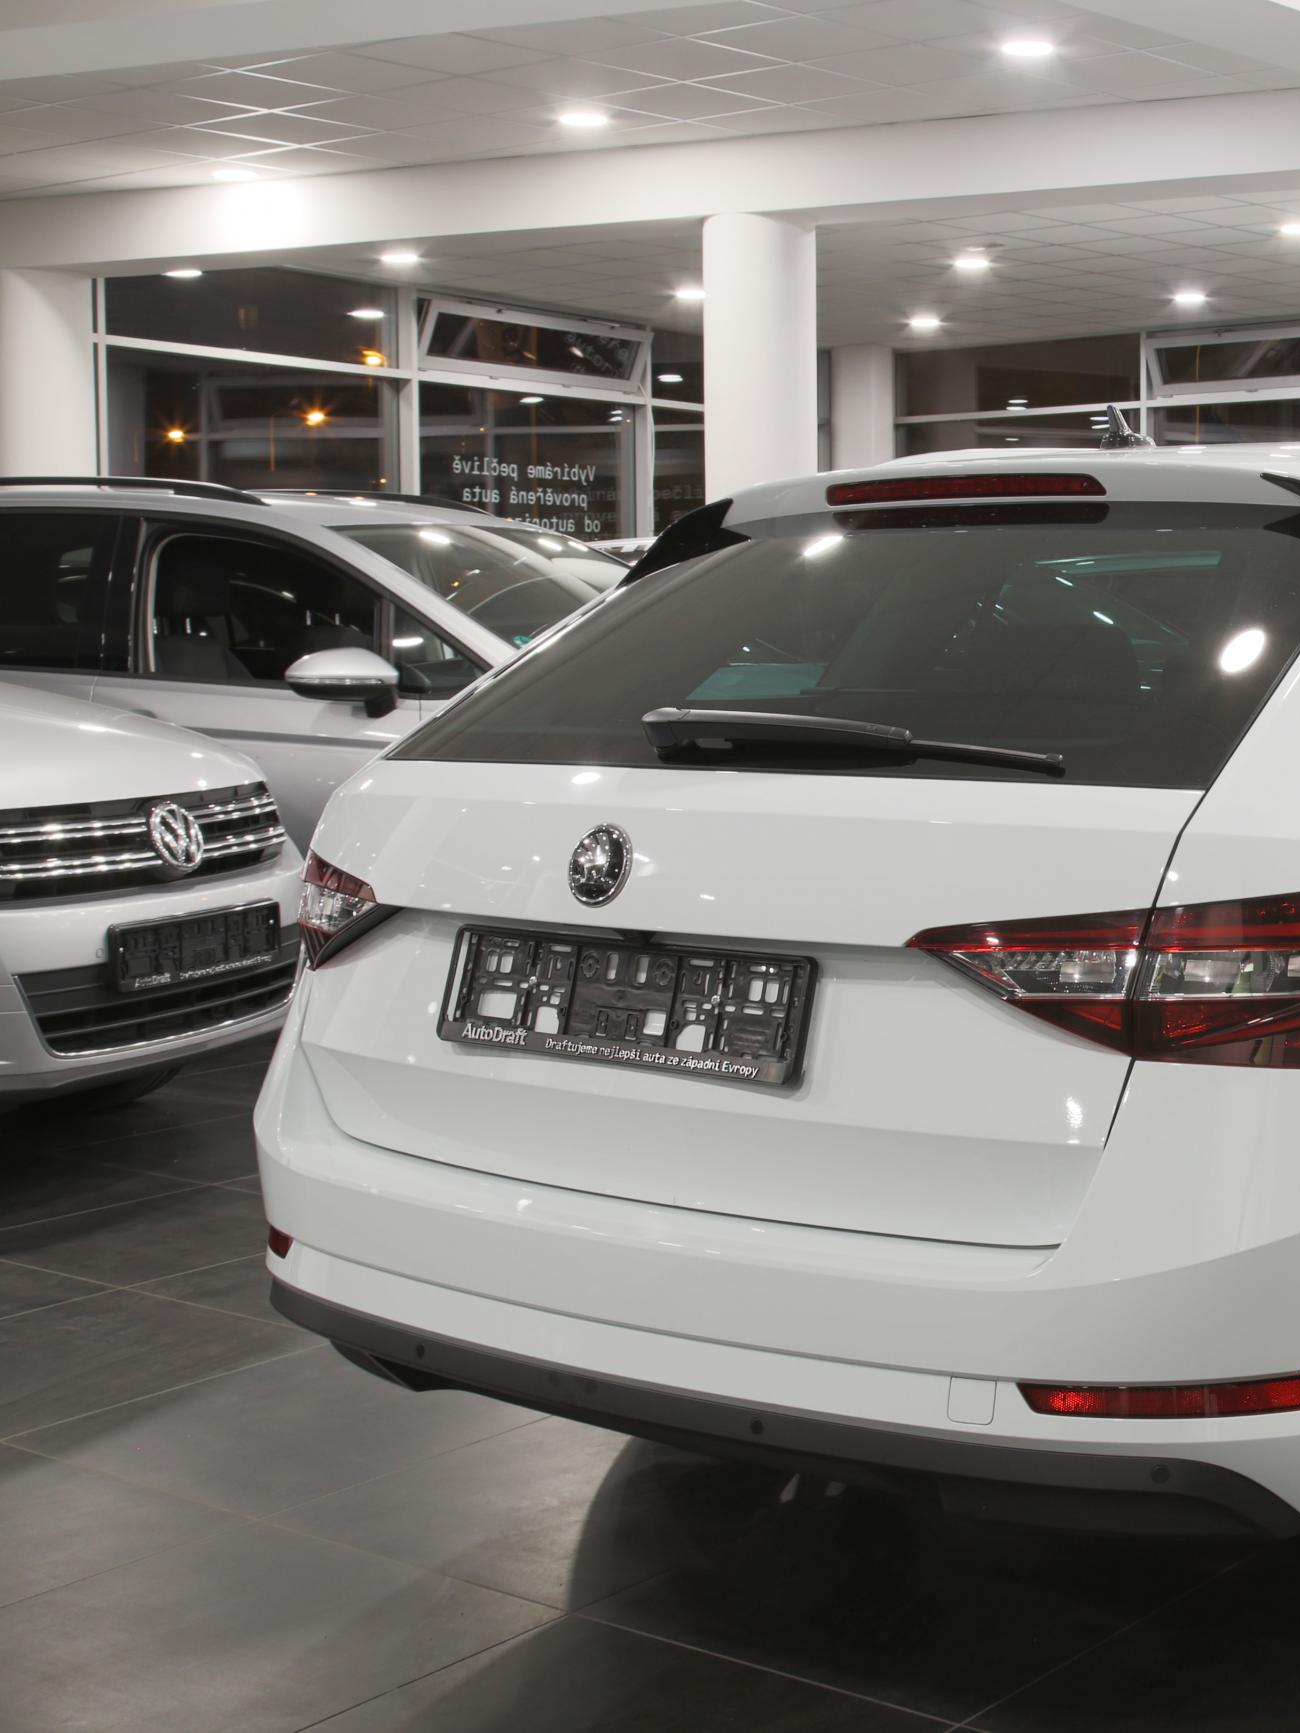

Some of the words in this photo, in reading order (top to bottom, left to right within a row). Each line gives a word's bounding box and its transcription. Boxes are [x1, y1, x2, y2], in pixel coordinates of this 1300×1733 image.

[461, 1022, 528, 1046] AutoDraft
[545, 1038, 598, 1055] Draftujeme
[642, 1052, 665, 1064] auta
[667, 1056, 679, 1065] ze
[721, 1060, 759, 1079] Evropy
